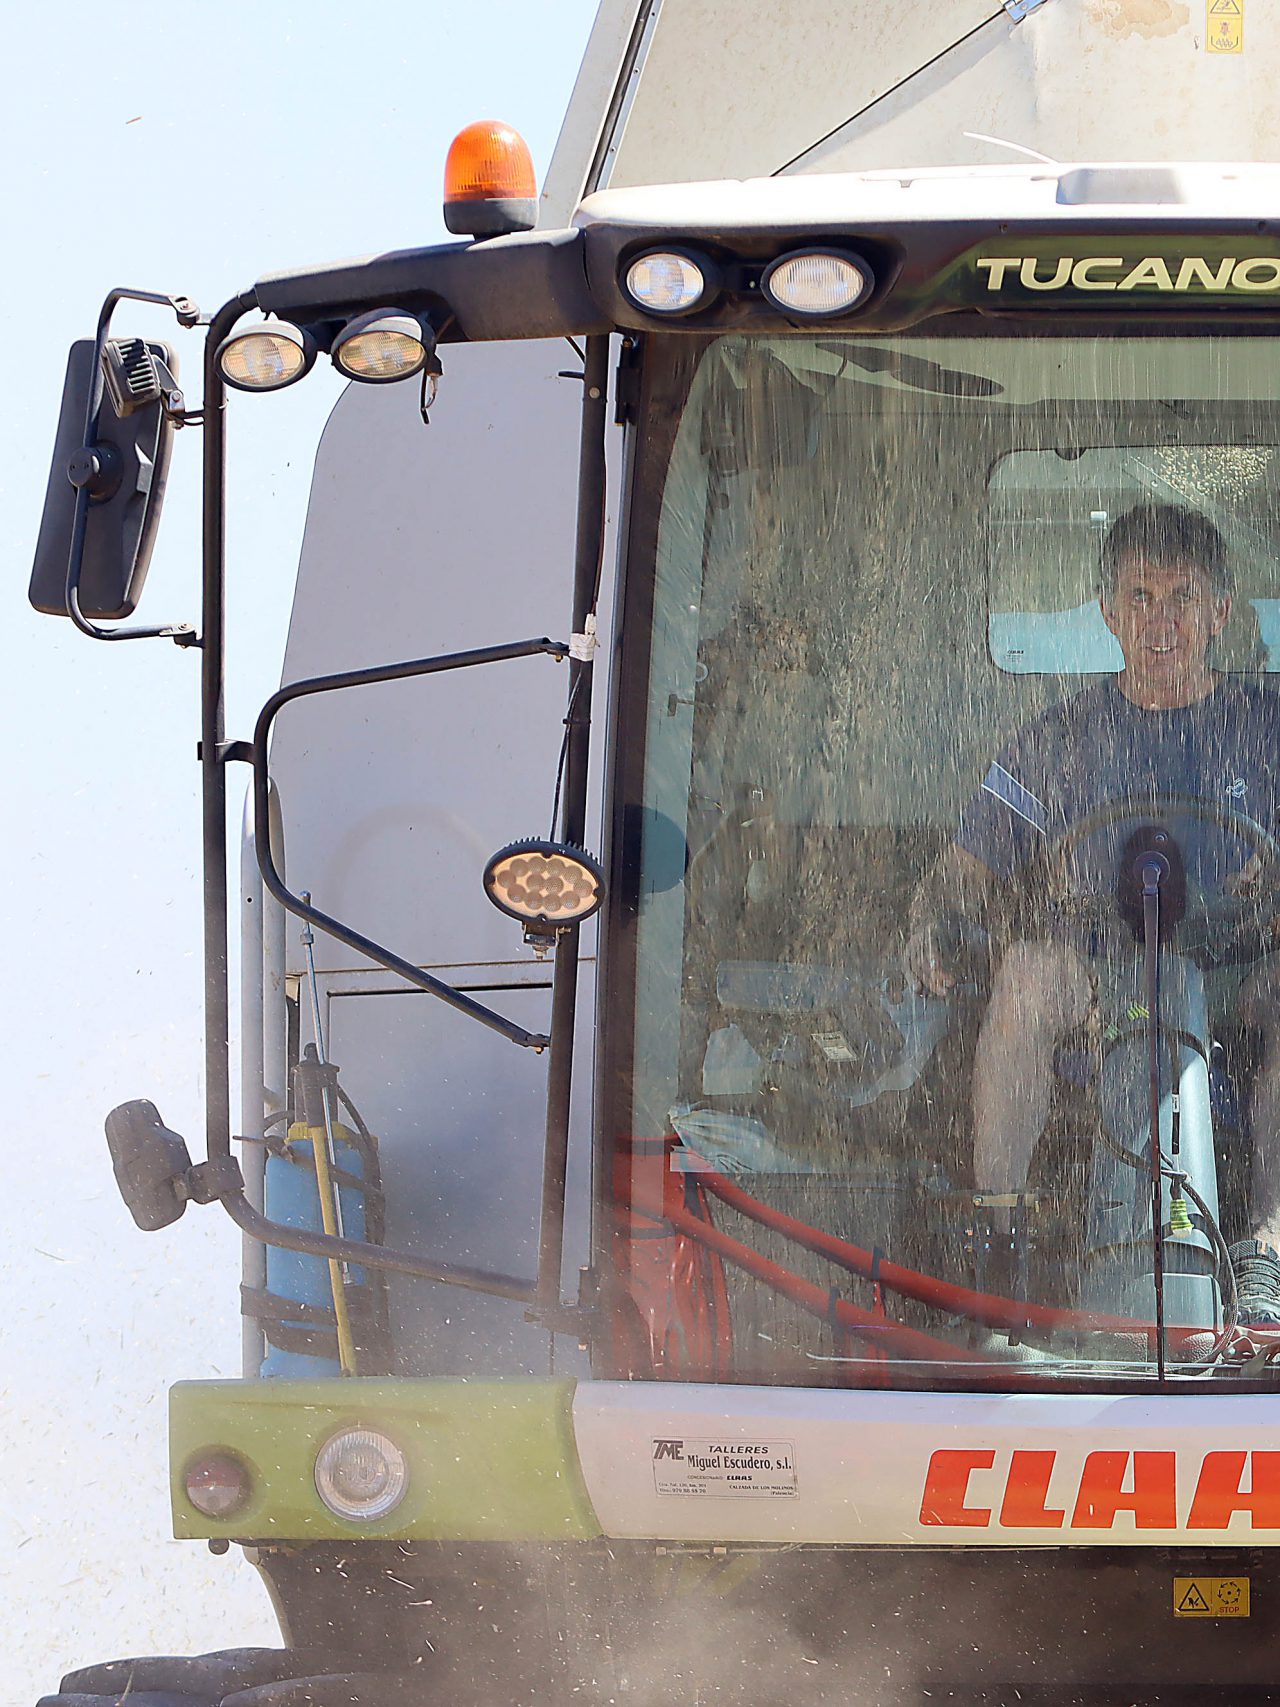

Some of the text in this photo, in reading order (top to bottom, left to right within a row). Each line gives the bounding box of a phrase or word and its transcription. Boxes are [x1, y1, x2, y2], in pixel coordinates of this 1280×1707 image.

[653, 1439, 684, 1460] TME
[708, 1445, 769, 1454] TALLERES
[687, 1455, 792, 1471] Miguel Escudero, s.l.
